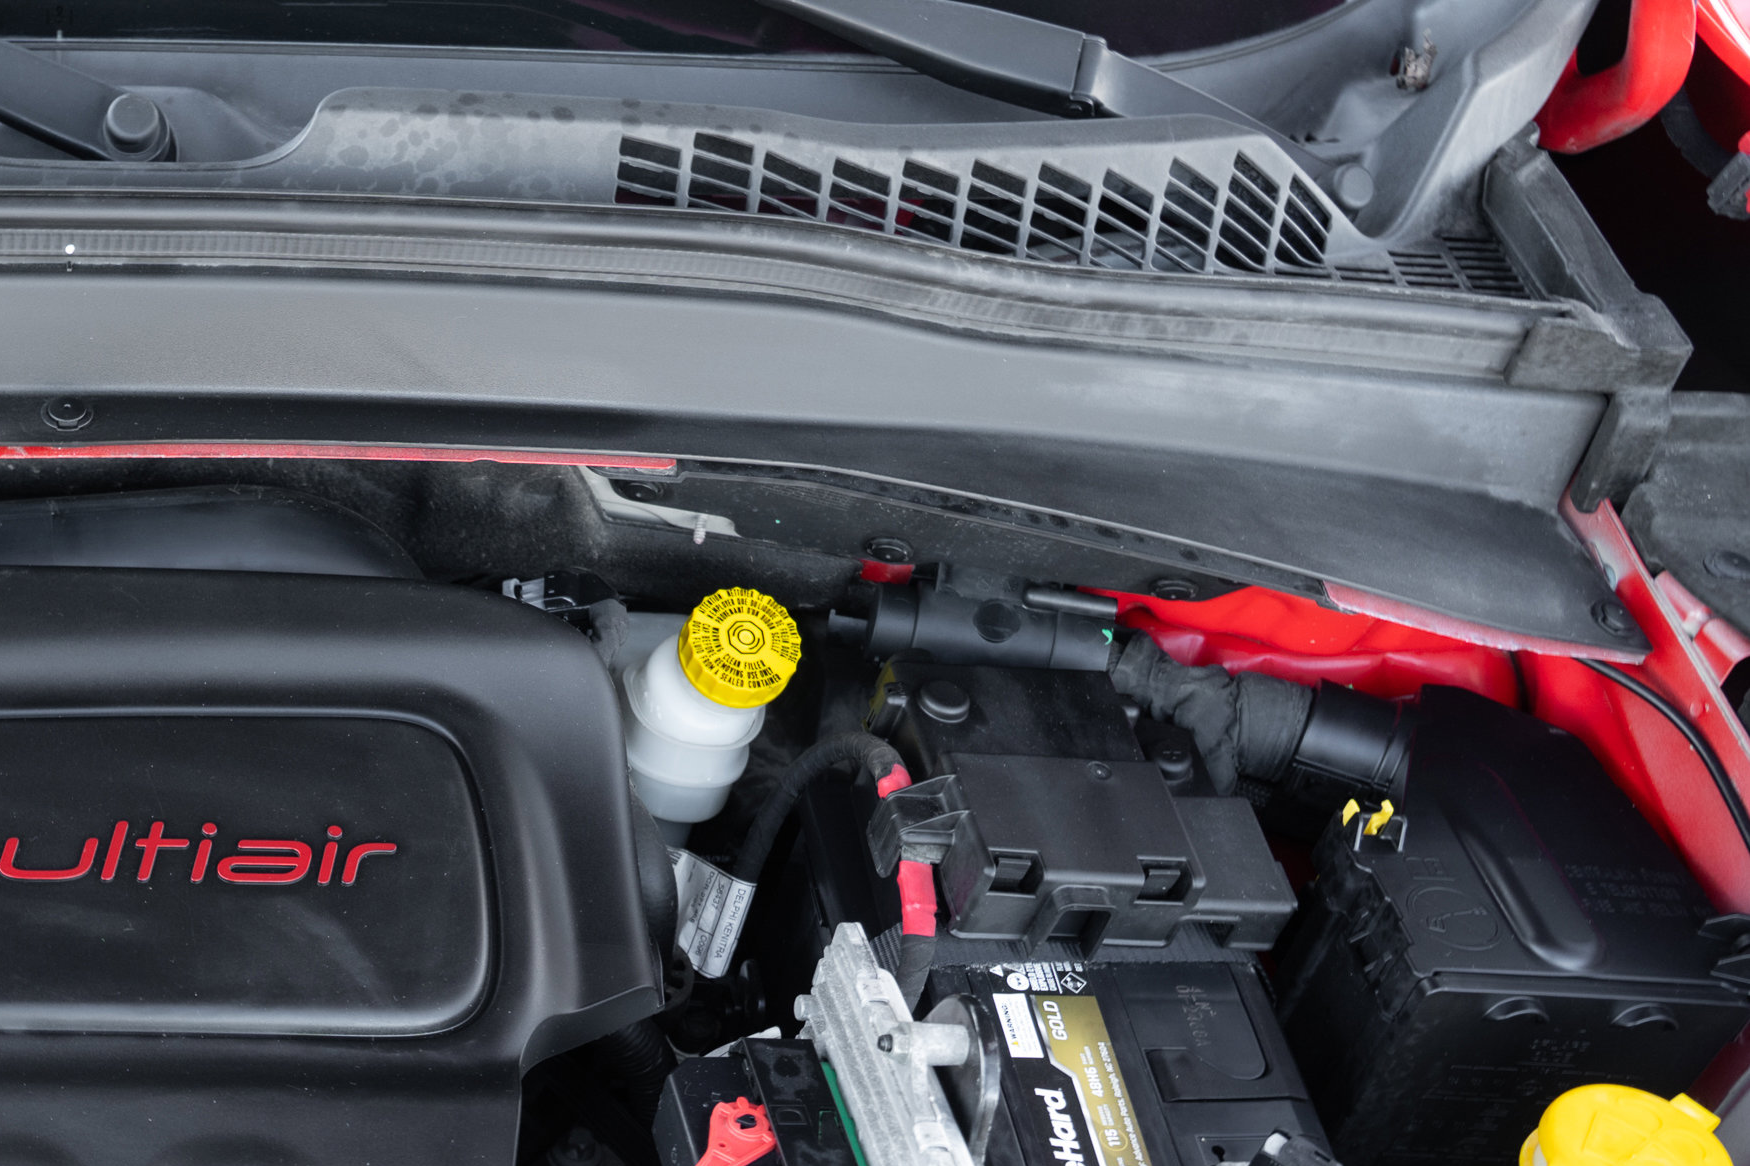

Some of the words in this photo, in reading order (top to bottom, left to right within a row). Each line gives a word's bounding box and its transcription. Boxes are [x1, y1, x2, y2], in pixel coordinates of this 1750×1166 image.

[700, 655, 715, 672] FROM
[720, 673, 744, 688] SEALED
[748, 673, 782, 688] CONTAINER
[714, 657, 744, 678] REMOVING
[747, 671, 759, 680] USE
[760, 668, 774, 678] ONLY
[723, 654, 741, 668] CLEAN
[744, 660, 766, 670] FILLER
[730, 888, 746, 922] DELPHI
[714, 922, 735, 959] KENITRA
[1043, 1000, 1068, 1041] GOLD
[1105, 1128, 1120, 1147] 115
[1122, 1116, 1134, 1132] Auto
[1127, 1133, 1143, 1160] Advance
